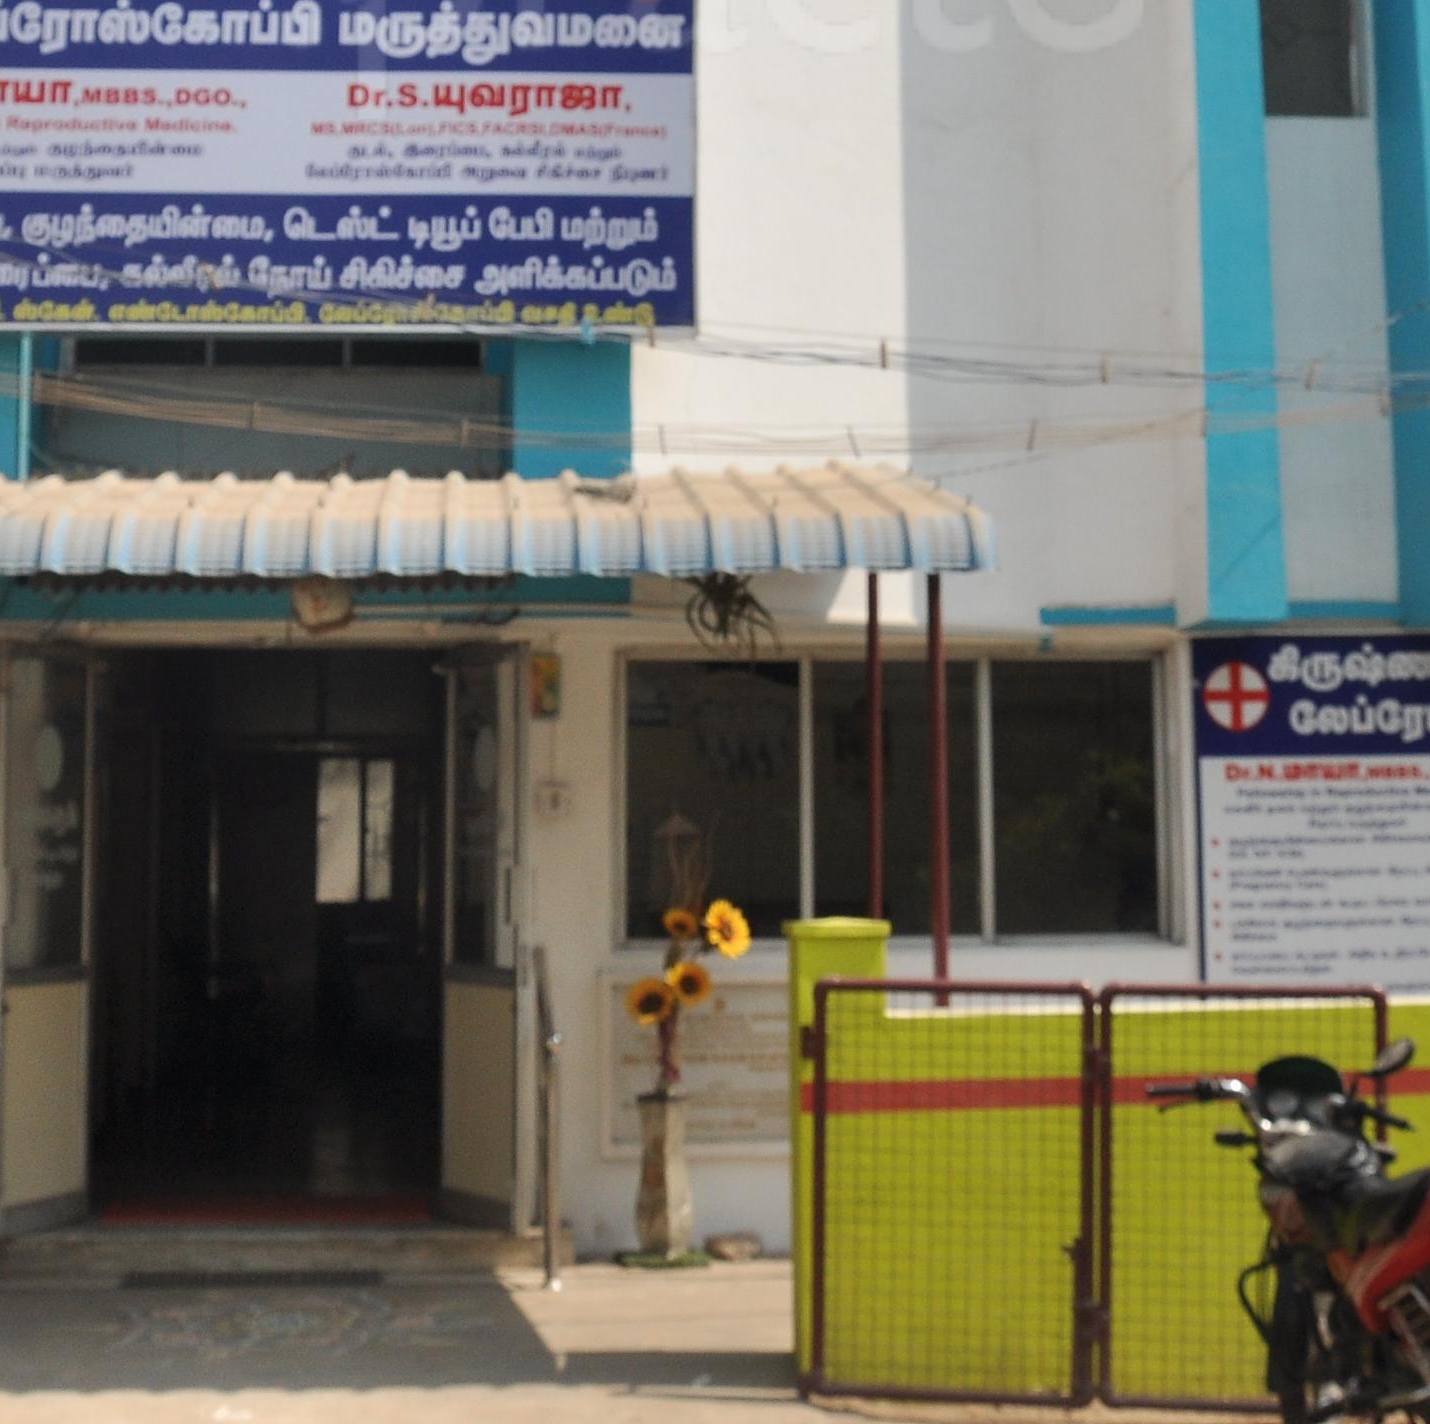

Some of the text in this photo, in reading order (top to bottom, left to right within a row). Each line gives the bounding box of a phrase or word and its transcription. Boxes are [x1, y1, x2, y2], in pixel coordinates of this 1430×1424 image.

[338, 0, 686, 65] மருத்துவமனை
[347, 82, 633, 116] Dr.S.யுவராஜா,
[7, 116, 138, 133] Reproductive
[21, 203, 274, 247] குழந்தையின்மை,
[284, 206, 399, 241] டெஸ்ட்
[408, 206, 482, 252] டியூப்
[488, 206, 554, 241] பேபி
[561, 206, 660, 251] மற்றும்
[247, 255, 333, 298] நோய்
[338, 256, 466, 291] சிகிச்சை
[474, 255, 678, 296] அளிக்கப்படும்
